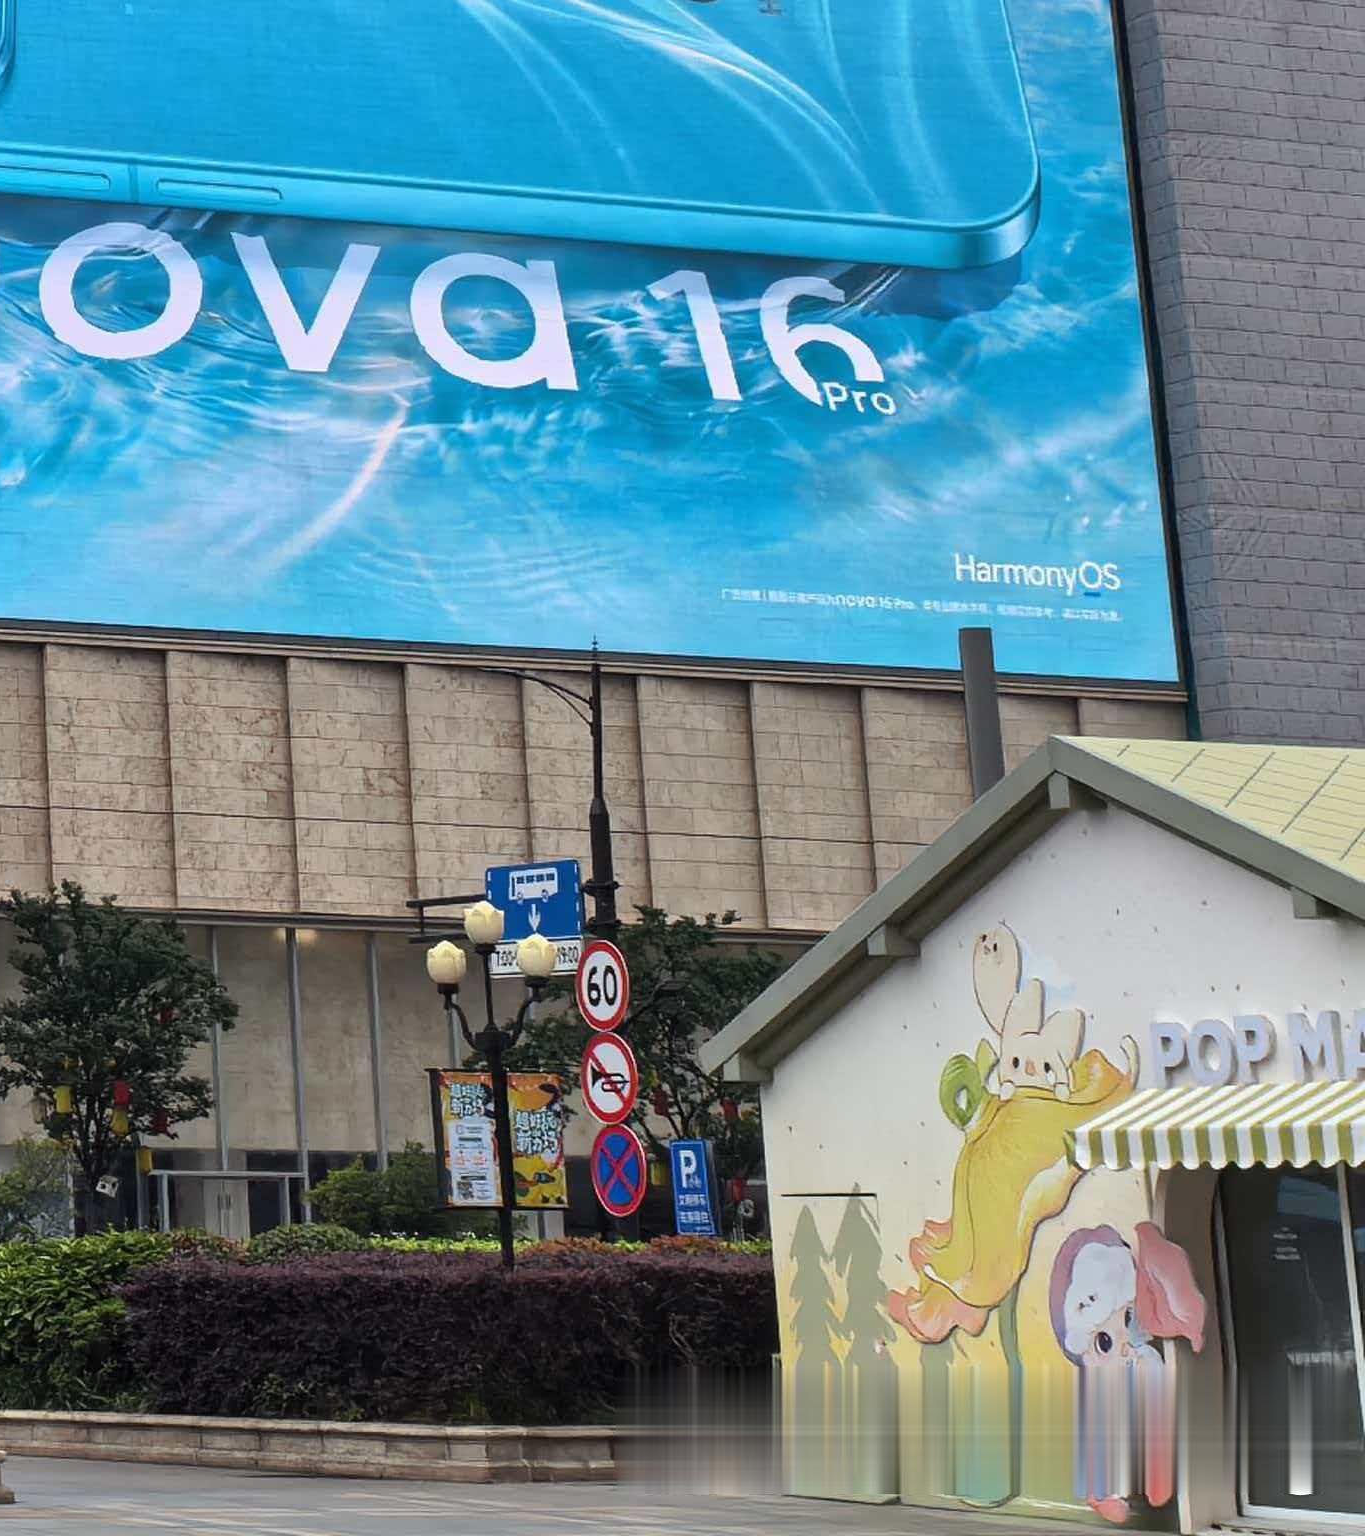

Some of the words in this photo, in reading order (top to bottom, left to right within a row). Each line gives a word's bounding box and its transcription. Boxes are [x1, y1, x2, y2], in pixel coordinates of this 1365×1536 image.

[646, 270, 885, 407] 16
[822, 382, 897, 415] Pro
[954, 552, 1121, 596] HarmonyOS
[587, 965, 617, 1007] 60
[1150, 1013, 1276, 1089] POP
[679, 1150, 697, 1188] P
